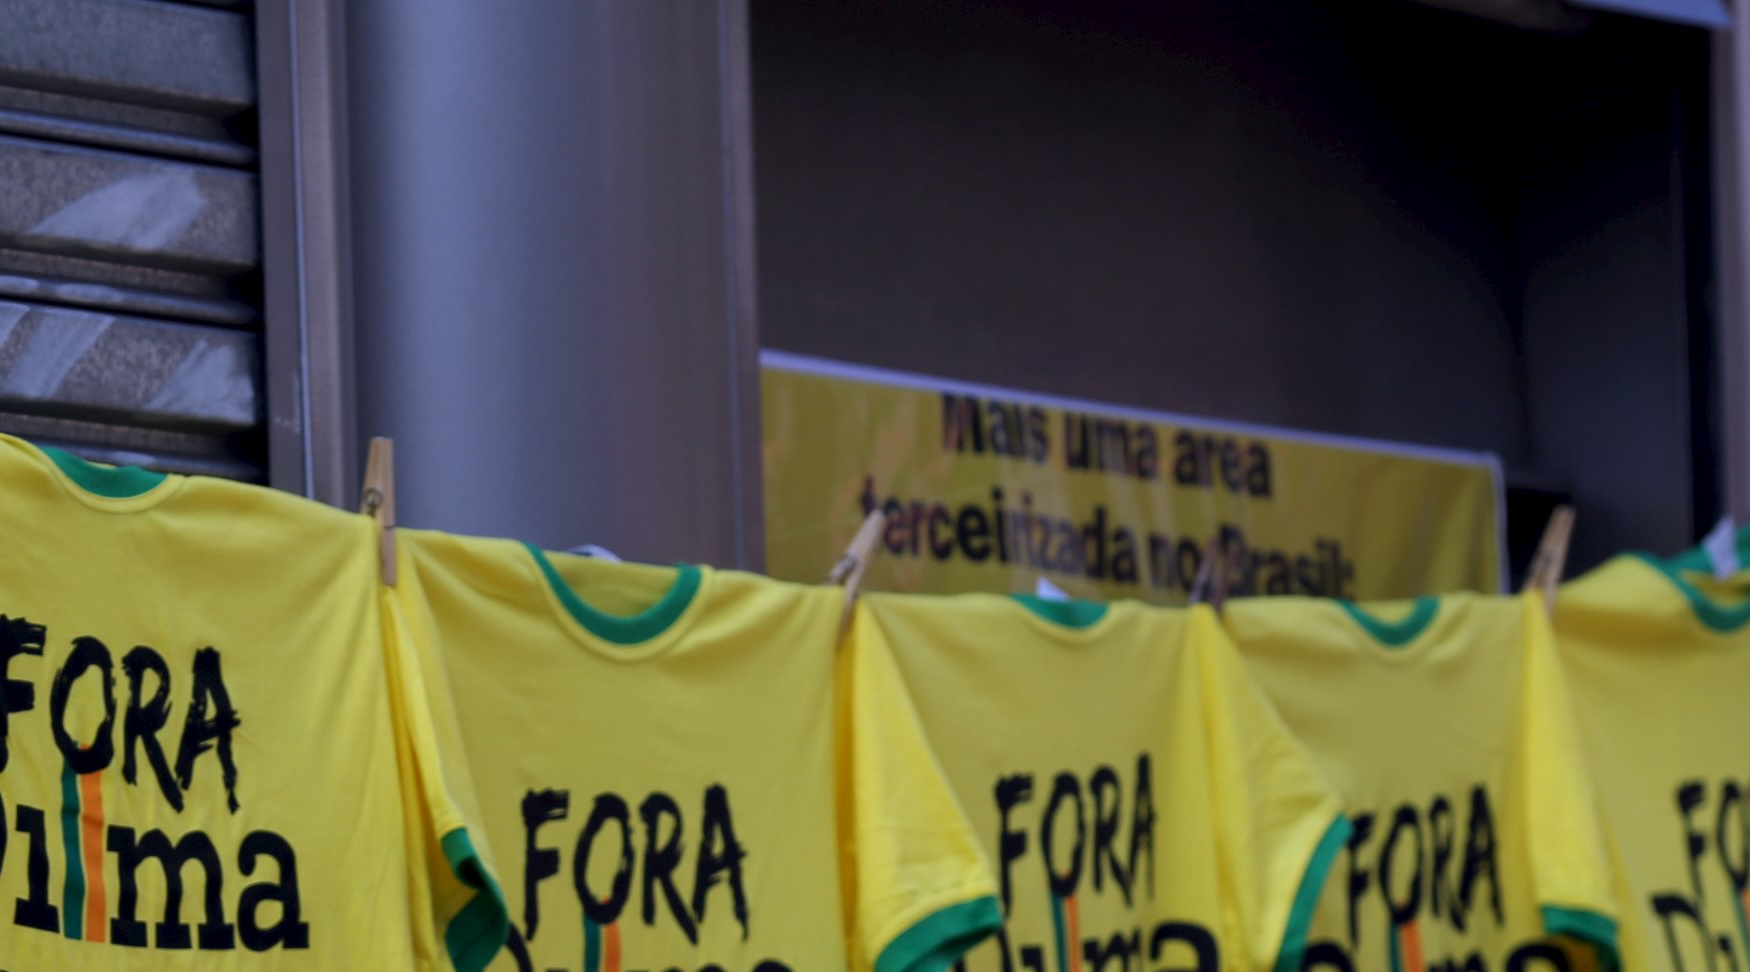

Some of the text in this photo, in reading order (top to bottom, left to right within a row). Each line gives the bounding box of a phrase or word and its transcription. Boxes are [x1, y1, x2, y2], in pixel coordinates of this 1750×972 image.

[1062, 411, 1159, 477] uma
[521, 782, 748, 945] FORA
[994, 751, 1158, 923] FORA
[1346, 783, 1504, 951] FORA
